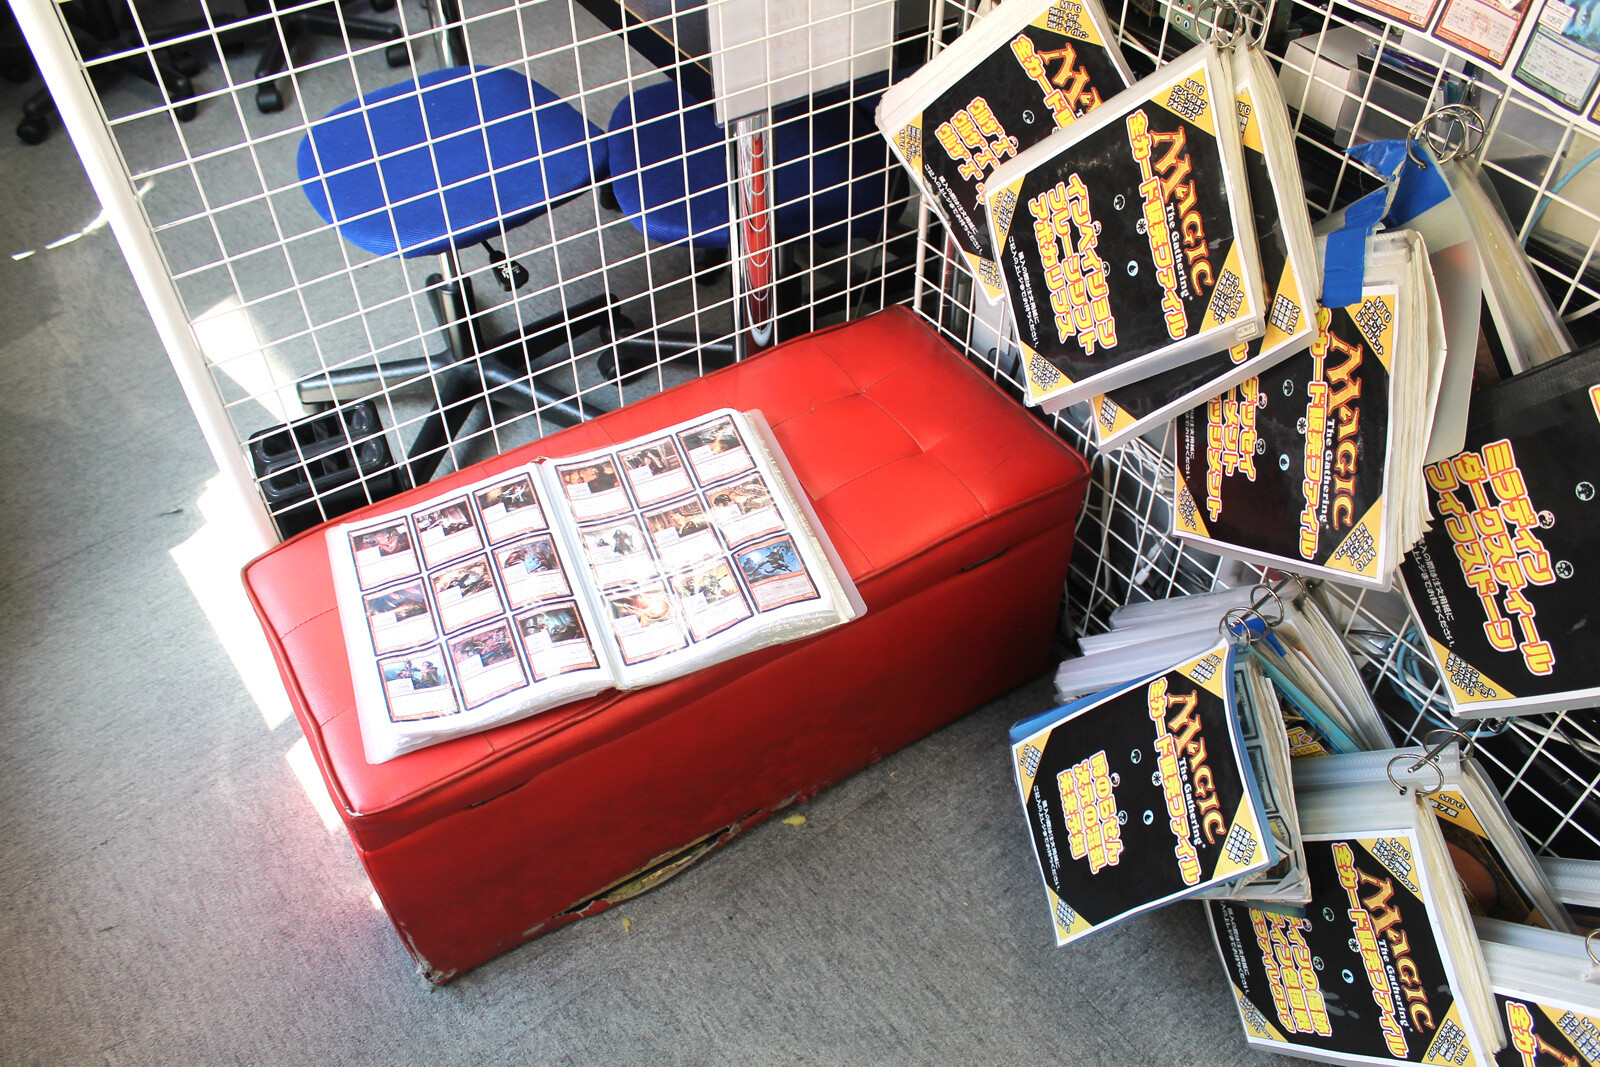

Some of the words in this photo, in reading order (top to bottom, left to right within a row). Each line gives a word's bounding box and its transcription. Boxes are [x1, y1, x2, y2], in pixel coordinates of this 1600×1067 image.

[1060, 0, 1082, 13] MTG
[1166, 99, 1196, 122] アポカリプス
[1170, 91, 1204, 116] プレーンシフト
[1173, 85, 1208, 109] インベイジョン
[1184, 78, 1205, 96] MTG
[1126, 108, 1189, 341] 全カード販売ファイル
[1150, 126, 1215, 296] MAGIC
[1028, 191, 1076, 344] アポカリプス
[1047, 181, 1097, 356] プレーンシフト
[1066, 172, 1118, 349] インベイジョン
[1166, 202, 1176, 231] The
[1172, 231, 1190, 298] Gathering
[1213, 271, 1235, 321] プレーンシフト
[1217, 277, 1240, 325] インベイジョン
[1229, 290, 1244, 318] MTG
[1287, 306, 1301, 335] MTG
[1360, 305, 1381, 338] トーメント
[1364, 299, 1387, 332] オデッセイ
[1374, 296, 1392, 323] MTG
[1355, 311, 1384, 355] ジャッジメント
[1325, 418, 1336, 447] The
[1326, 331, 1363, 530] MAGIC
[1319, 450, 1334, 525] Gathering
[1481, 438, 1556, 586] ミラディン
[1356, 547, 1376, 572] MTG
[1425, 459, 1518, 652] フィフスドーン
[1453, 451, 1556, 675] ダークスティール
[1450, 674, 1475, 697] MTG
[1148, 676, 1202, 887] 全カード販売ファイル
[1167, 689, 1227, 845] MAGIC
[1057, 769, 1088, 860] 未来予知
[1072, 759, 1108, 874] 次元の混乱
[1089, 750, 1124, 866] 時のらせん
[1179, 756, 1188, 781] The
[1184, 783, 1203, 848] Gathering
[1439, 794, 1466, 810] MTG
[1242, 838, 1257, 865] MTG
[1390, 838, 1411, 860] MTG
[1332, 843, 1409, 1059] 全カード販売ファイル
[1356, 867, 1436, 1033] MAGIC
[1377, 939, 1389, 963] The
[1386, 964, 1410, 1028] Gathering
[1454, 1044, 1470, 1066] MTG
